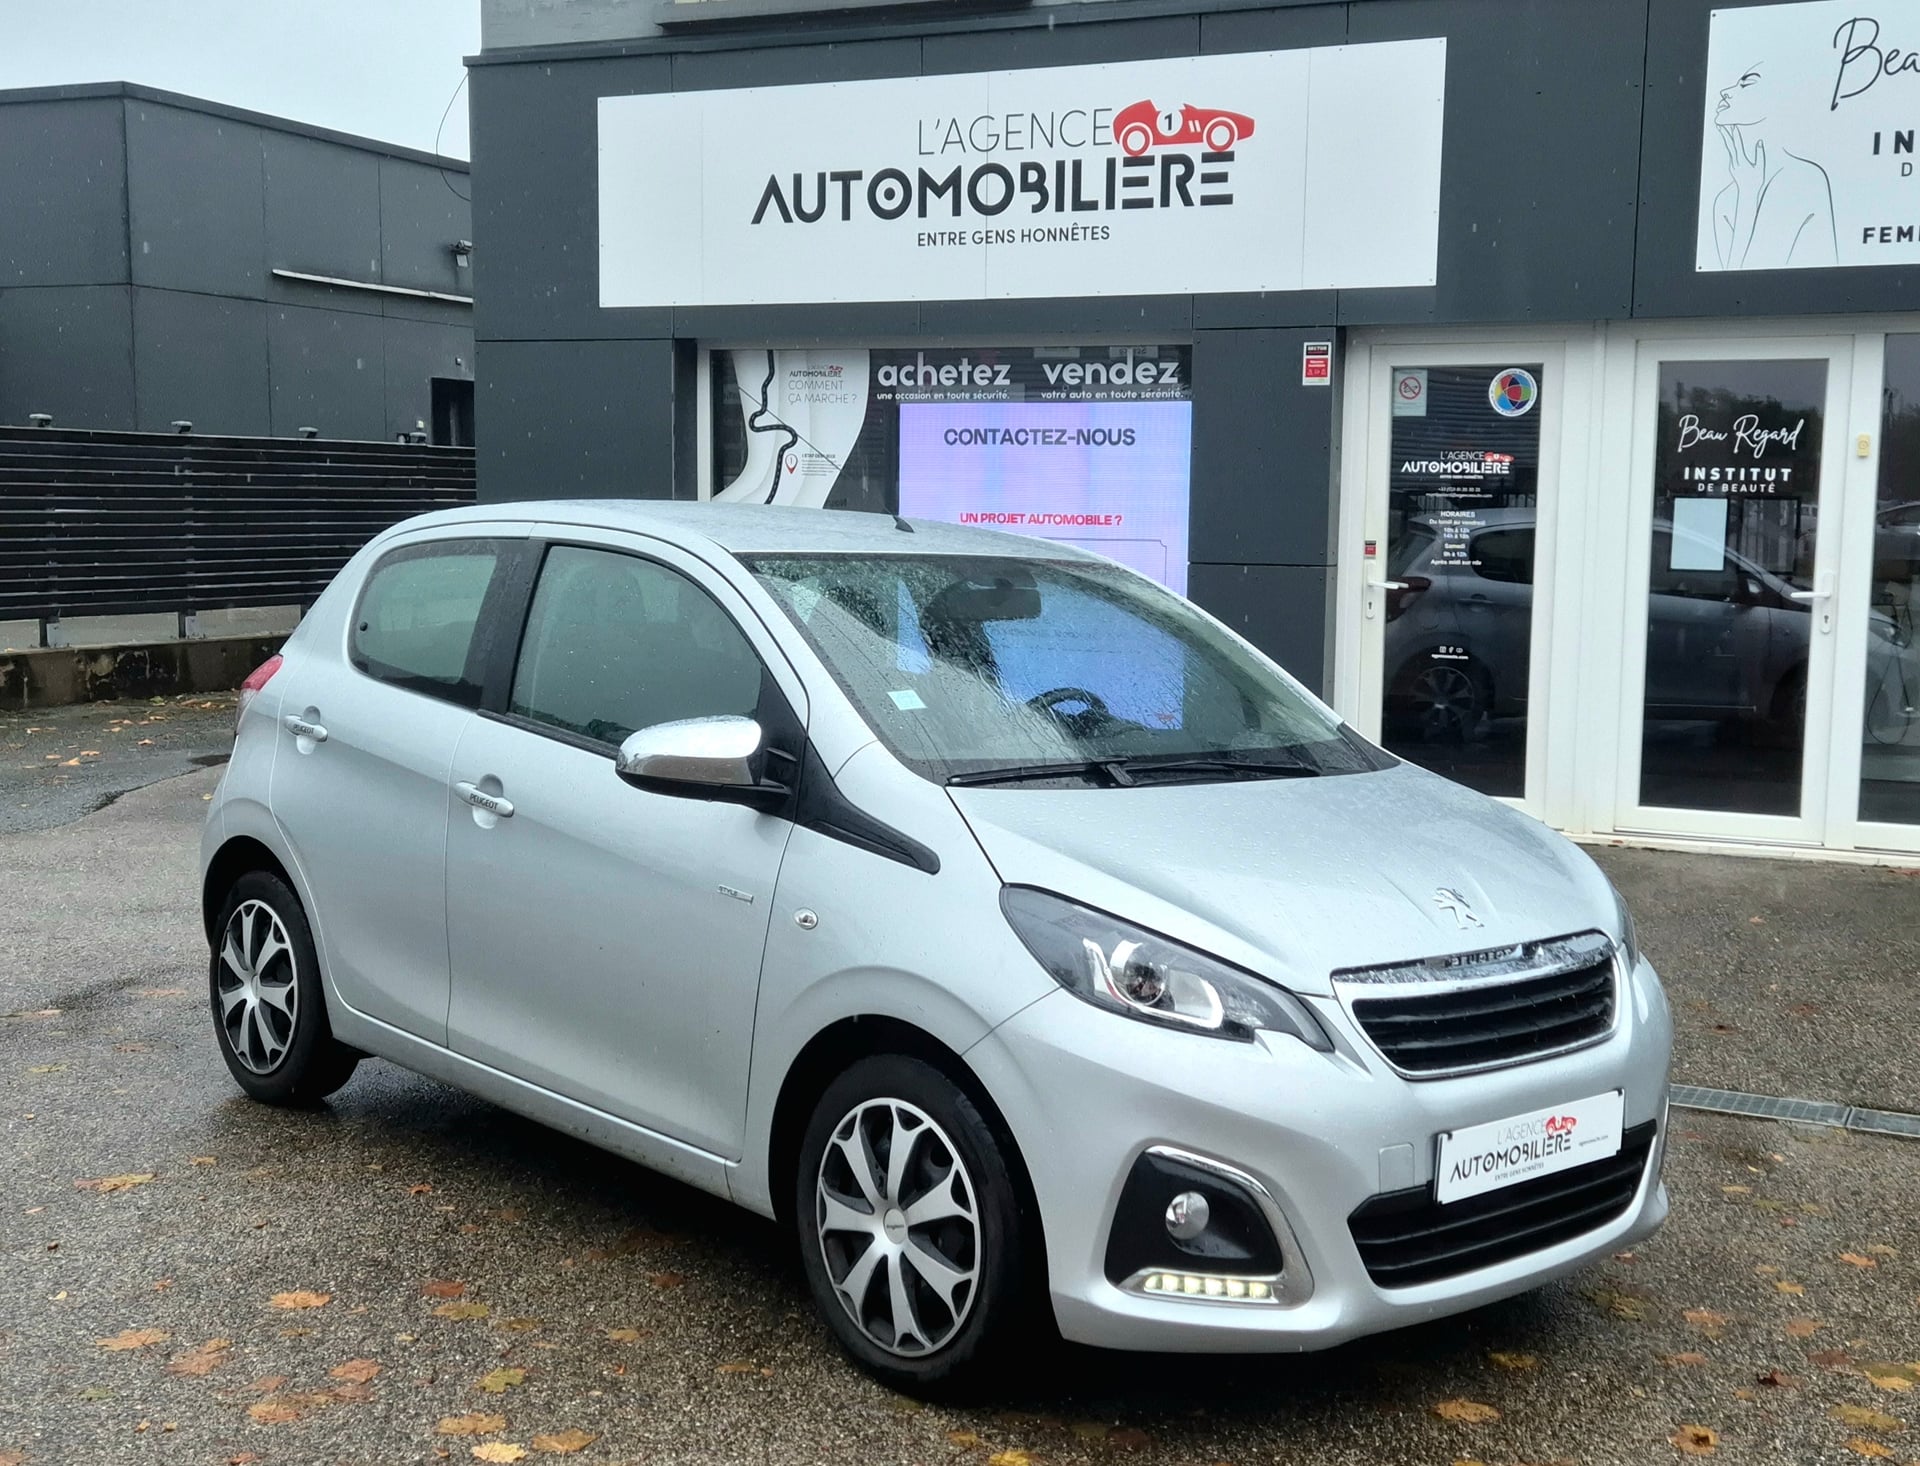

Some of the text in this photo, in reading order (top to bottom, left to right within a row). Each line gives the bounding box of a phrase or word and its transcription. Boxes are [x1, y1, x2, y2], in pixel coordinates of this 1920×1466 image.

[918, 108, 1113, 155] L'AGENCE
[918, 222, 1110, 247] ENTRE GENS HONNÊTES
[877, 352, 1012, 386] achetez
[1042, 348, 1180, 385] vendez
[788, 380, 844, 391] COMMENT
[1040, 390, 1067, 399] votre
[1069, 390, 1092, 399] auto
[1110, 390, 1137, 399] toute
[1140, 387, 1184, 398] sérénité.
[788, 393, 858, 405] ÇA MARCHE ?
[895, 391, 931, 400] occasion
[947, 391, 970, 400] toute
[972, 390, 1010, 400] sécurité.
[944, 428, 1136, 446] CONTACTEZ-NOUS
[1677, 414, 1805, 458] Beau Regard
[1440, 451, 1485, 460] L'AGENCE
[1684, 467, 1792, 481] INSTITUT
[1697, 482, 1775, 493] DE BEAUTÉ
[960, 512, 1122, 526] UN PROJET AUTOMOBILE ?
[470, 793, 499, 810] PEUGEOT
[1497, 1118, 1546, 1145] L'AGENCE
